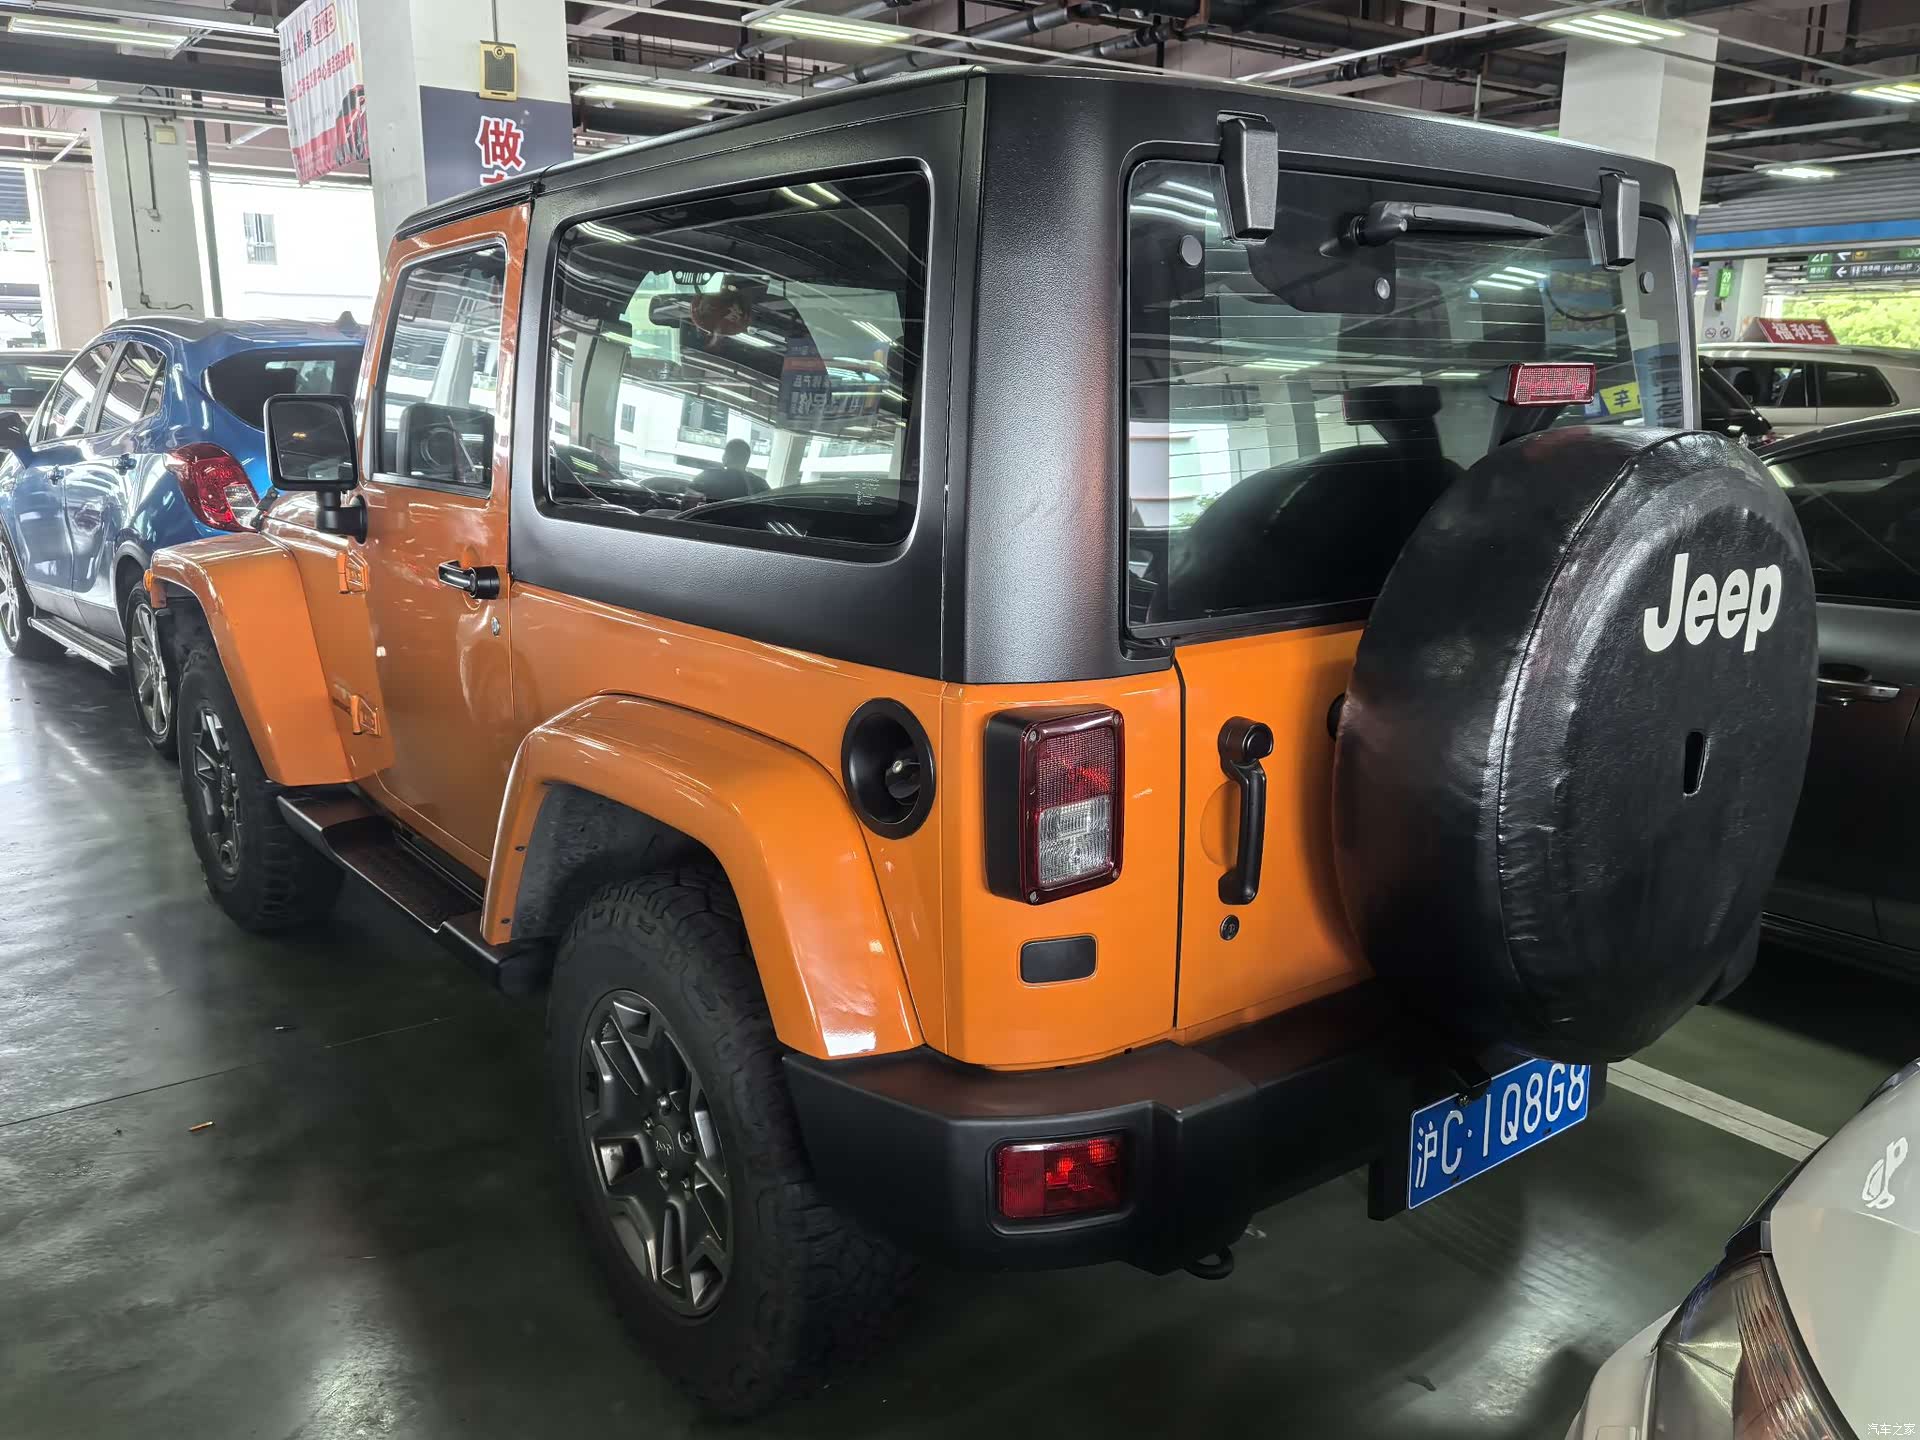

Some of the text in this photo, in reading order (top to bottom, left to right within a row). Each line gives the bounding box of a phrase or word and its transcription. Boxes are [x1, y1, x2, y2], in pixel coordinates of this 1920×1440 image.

[475, 115, 526, 185] 做
[1771, 321, 1829, 341] 福利车
[1643, 552, 1782, 653] Jeep
